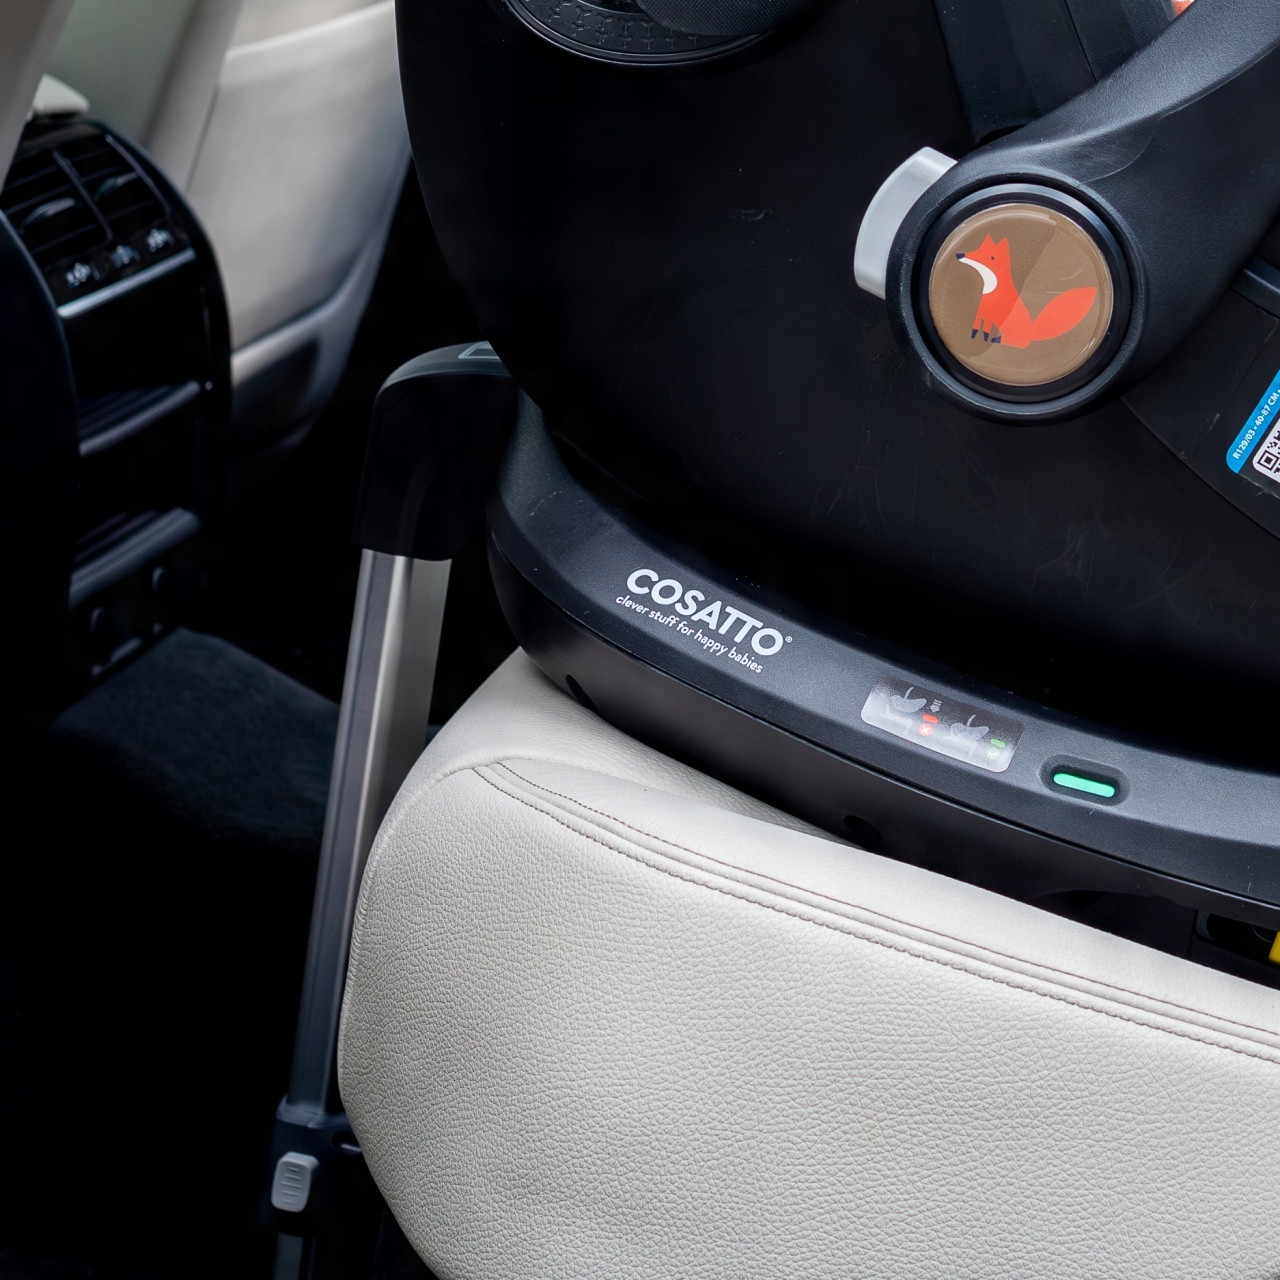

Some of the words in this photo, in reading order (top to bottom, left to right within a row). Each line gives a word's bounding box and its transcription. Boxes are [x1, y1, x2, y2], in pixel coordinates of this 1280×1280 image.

[1233, 429, 1255, 459] R129/03
[1255, 405, 1271, 426] 40-87
[1268, 392, 1279, 406] CM
[616, 595, 649, 614] clever
[649, 610, 679, 628] stuff
[678, 620, 694, 637] for
[694, 629, 728, 656] happy
[728, 648, 763, 673] babies
